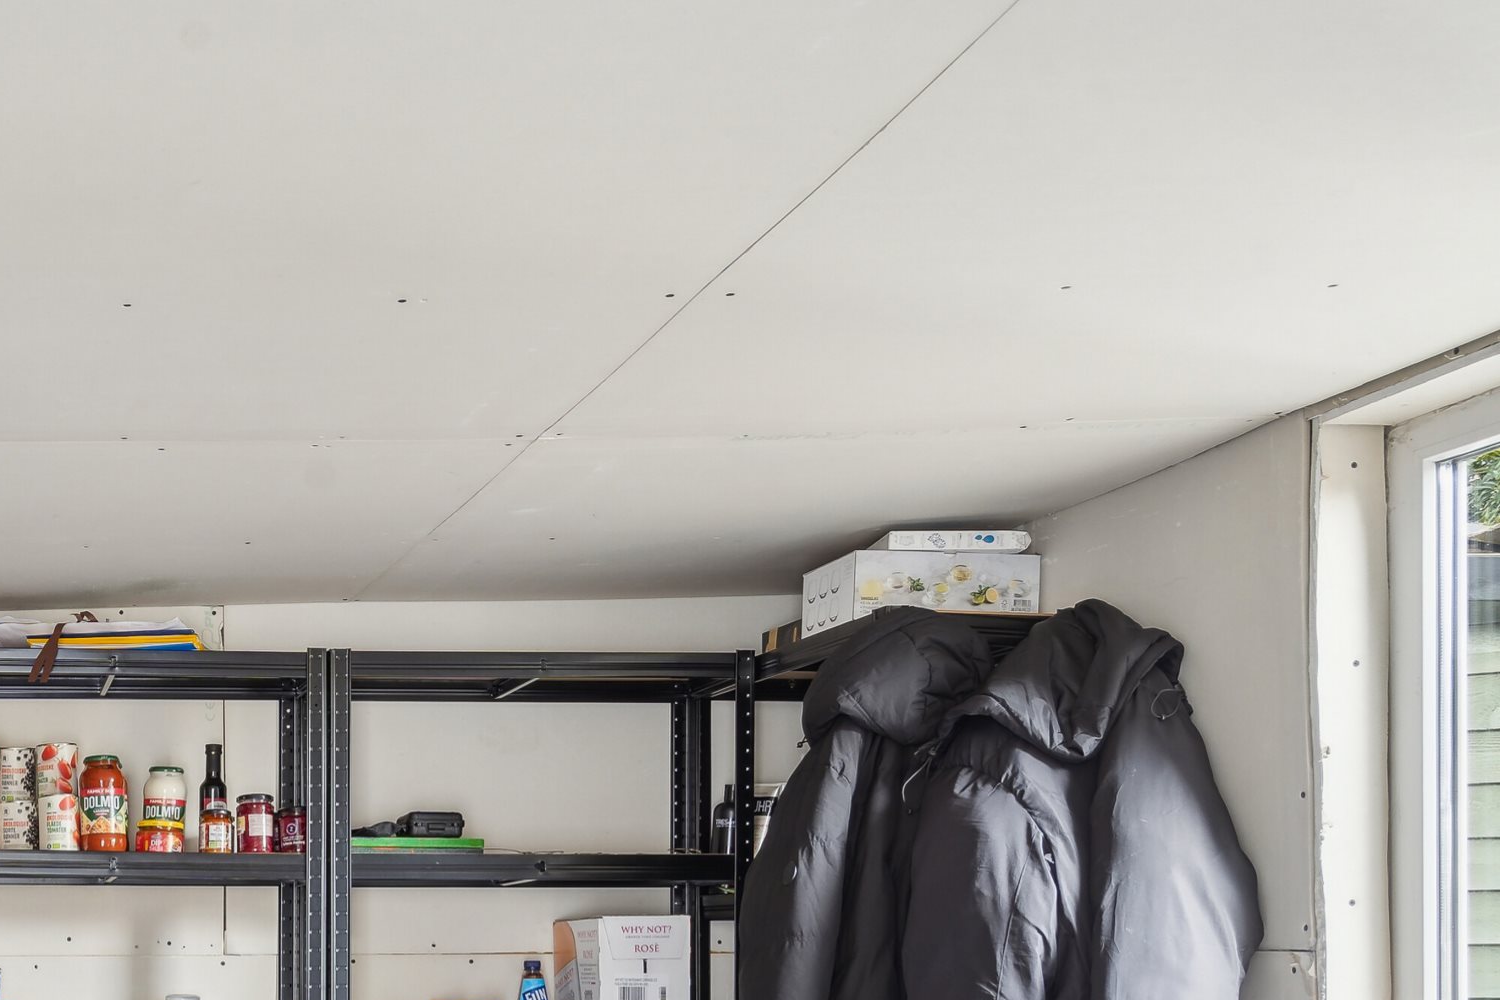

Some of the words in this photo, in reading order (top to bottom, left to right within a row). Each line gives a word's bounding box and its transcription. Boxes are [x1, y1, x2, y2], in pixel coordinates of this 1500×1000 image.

[83, 796, 120, 811] DOLMIO
[145, 805, 180, 820] DOLMIO
[621, 926, 644, 934] WHY
[646, 925, 672, 934] NOT?
